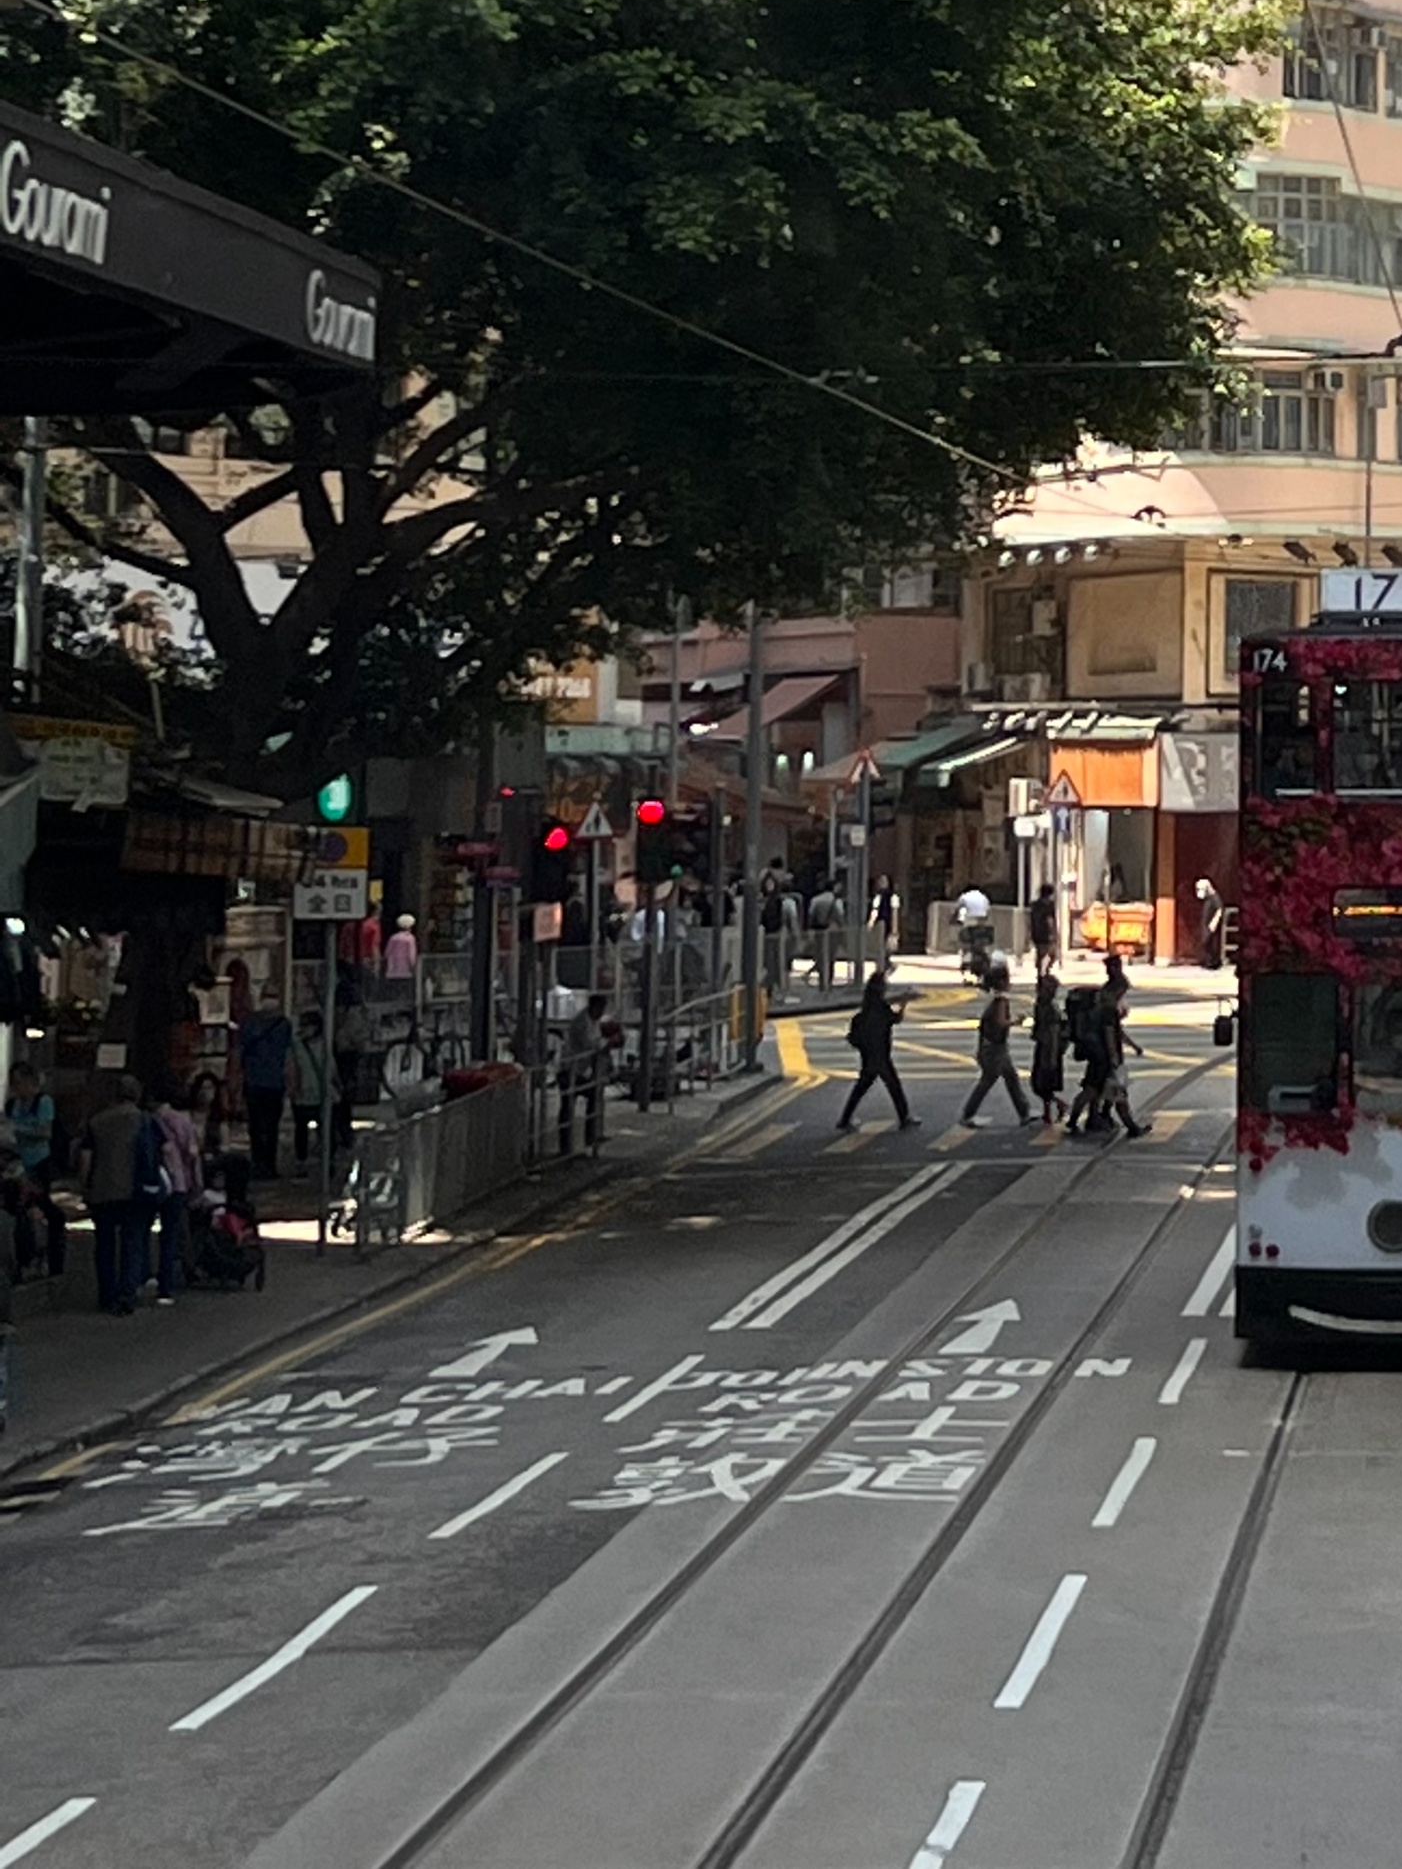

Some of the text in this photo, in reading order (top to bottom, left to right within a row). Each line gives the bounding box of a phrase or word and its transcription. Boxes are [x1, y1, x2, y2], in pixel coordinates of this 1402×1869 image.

[1253, 647, 1288, 673] 174
[400, 1377, 634, 1403] CHAI
[699, 1380, 1020, 1412] ROAD
[195, 1404, 504, 1435] ROAD
[568, 1448, 986, 1508] 敦道
